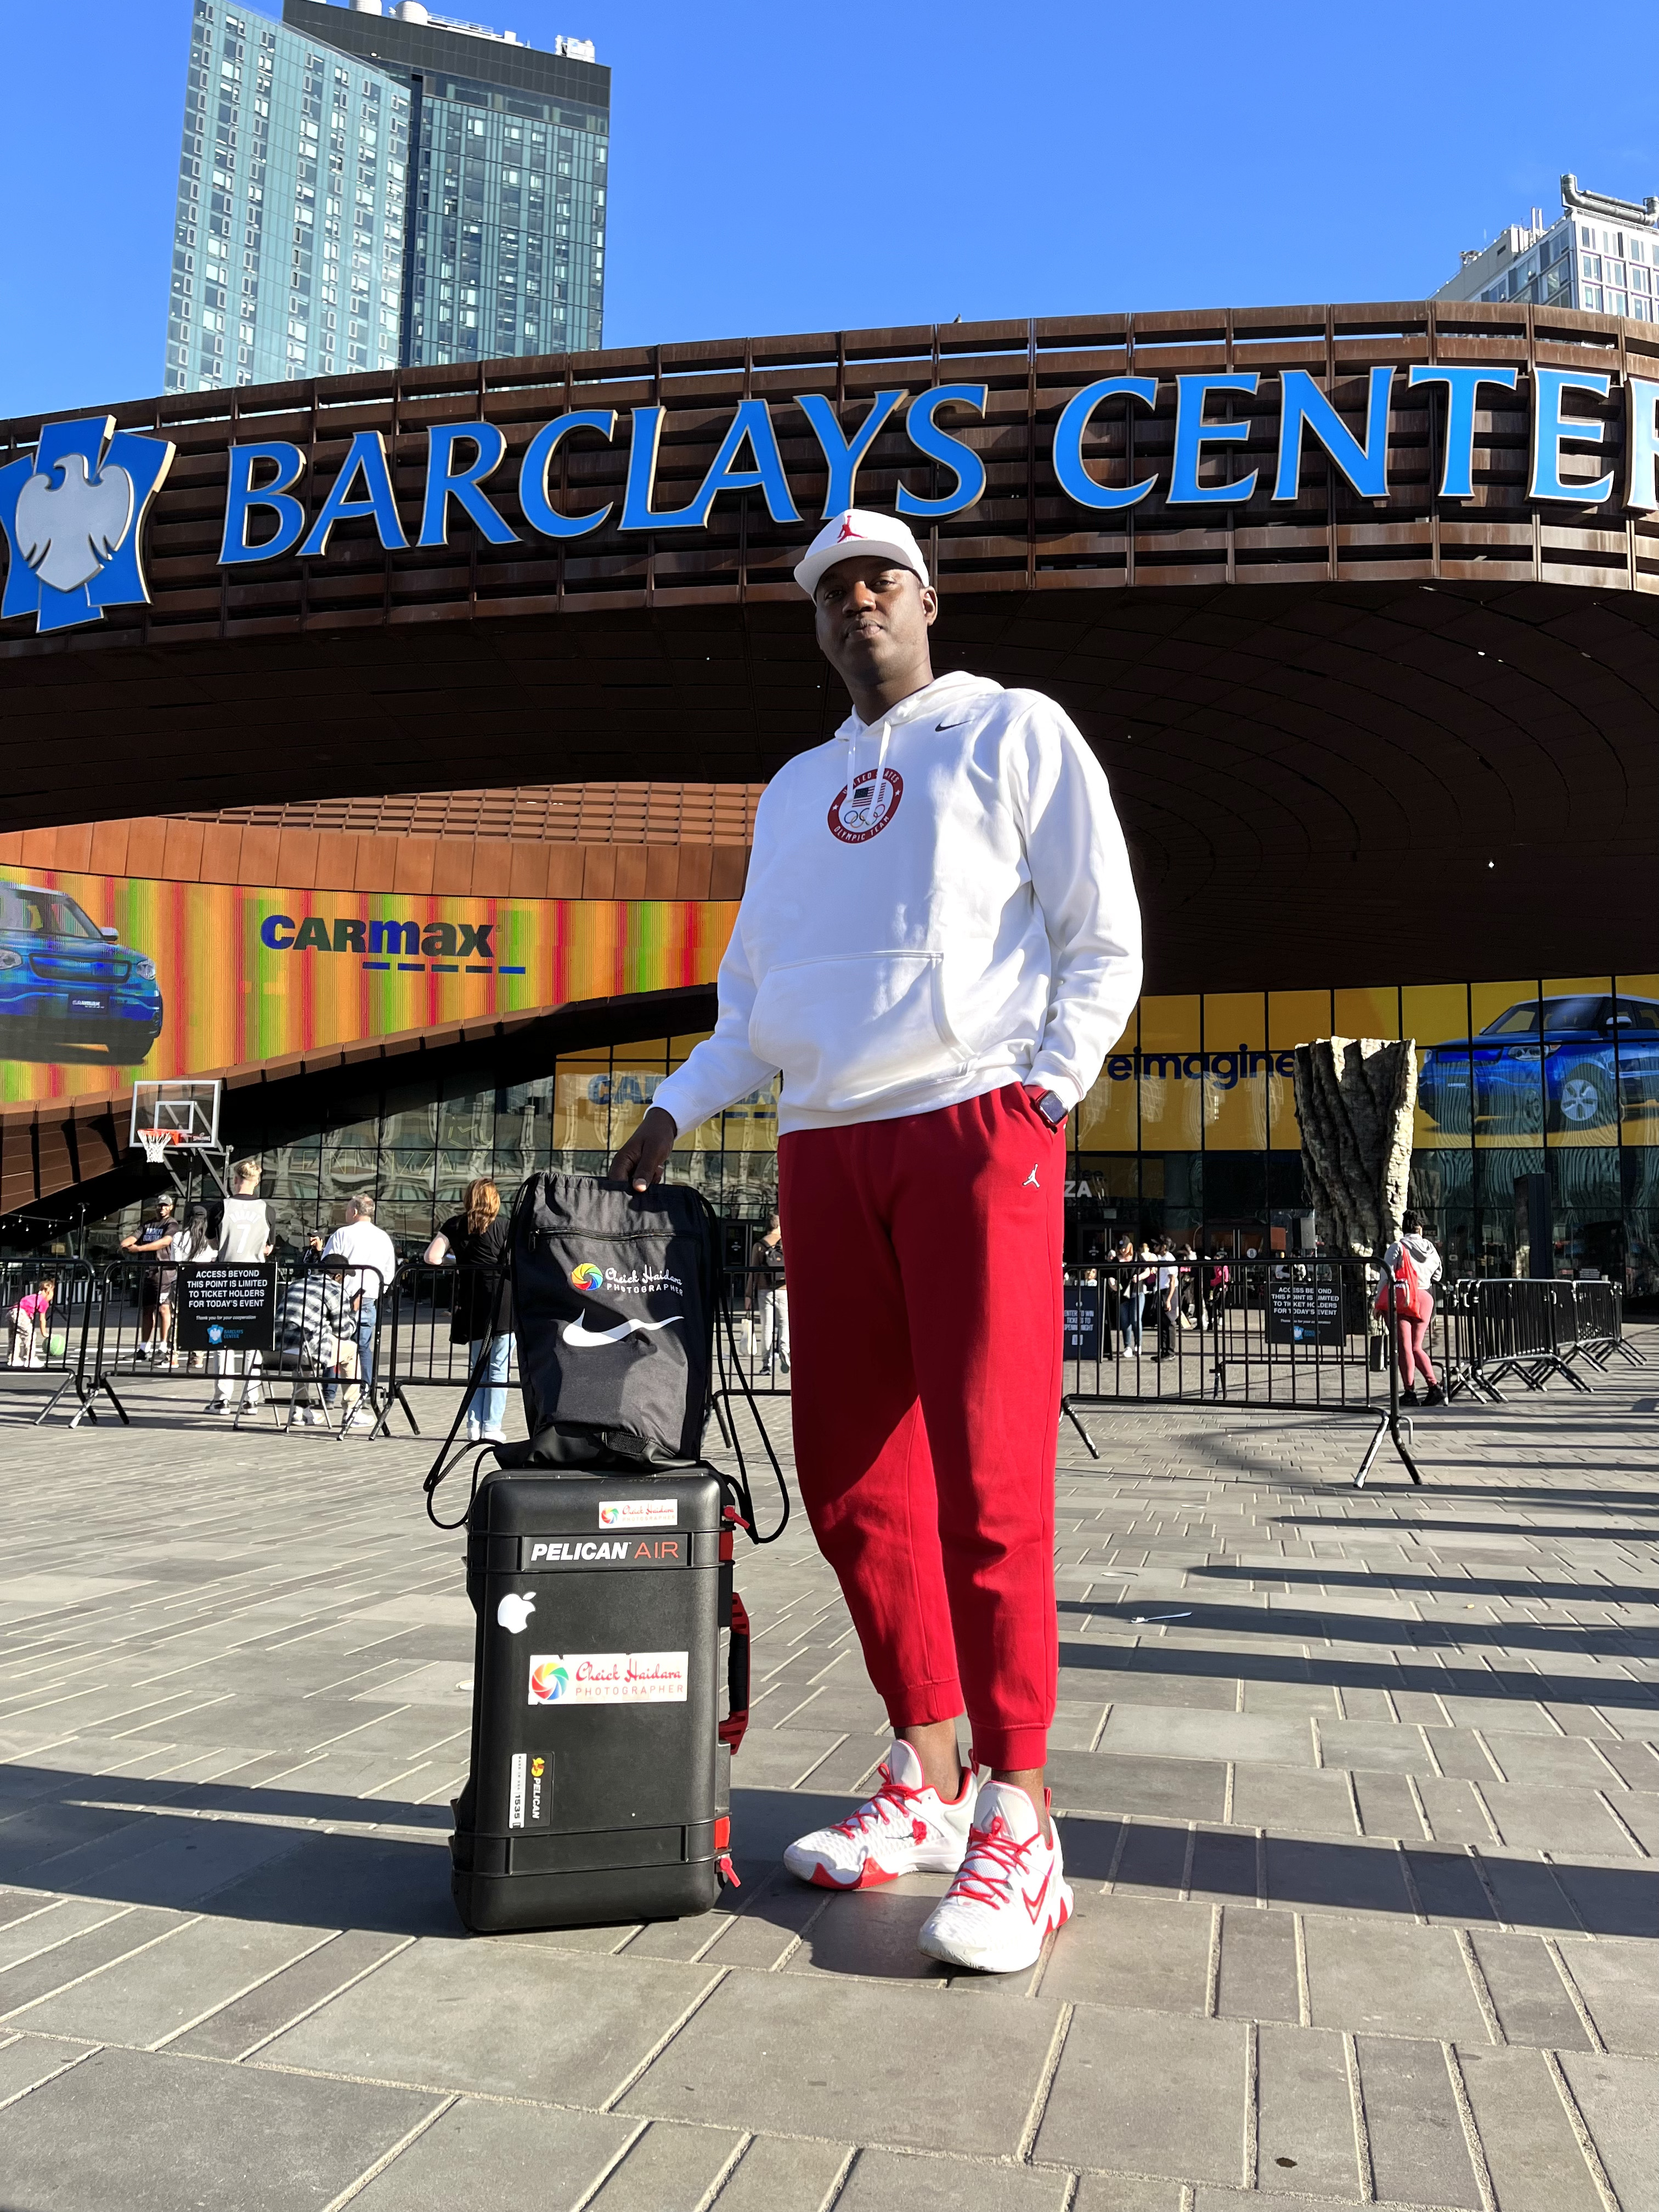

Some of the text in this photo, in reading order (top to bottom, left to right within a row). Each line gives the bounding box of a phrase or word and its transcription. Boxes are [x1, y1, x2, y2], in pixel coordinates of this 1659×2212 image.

[218, 382, 988, 565] BARCLAYS
[843, 772, 872, 794] UTED
[834, 816, 889, 842] OLYMPIC TEAM
[1105, 1043, 1296, 1090] eimagine
[237, 1224, 251, 1254] 7
[205, 1280, 228, 1288] POINT
[228, 1269, 259, 1278] BEYOND
[606, 1283, 684, 1297] PHOTOGRAPHER
[531, 1542, 679, 1561] PELICAN AIR
[576, 1658, 682, 1683] Cheick Haidara
[576, 1684, 684, 1696] PHOTOGRAPHER
[532, 1777, 541, 1819] PELICAN
